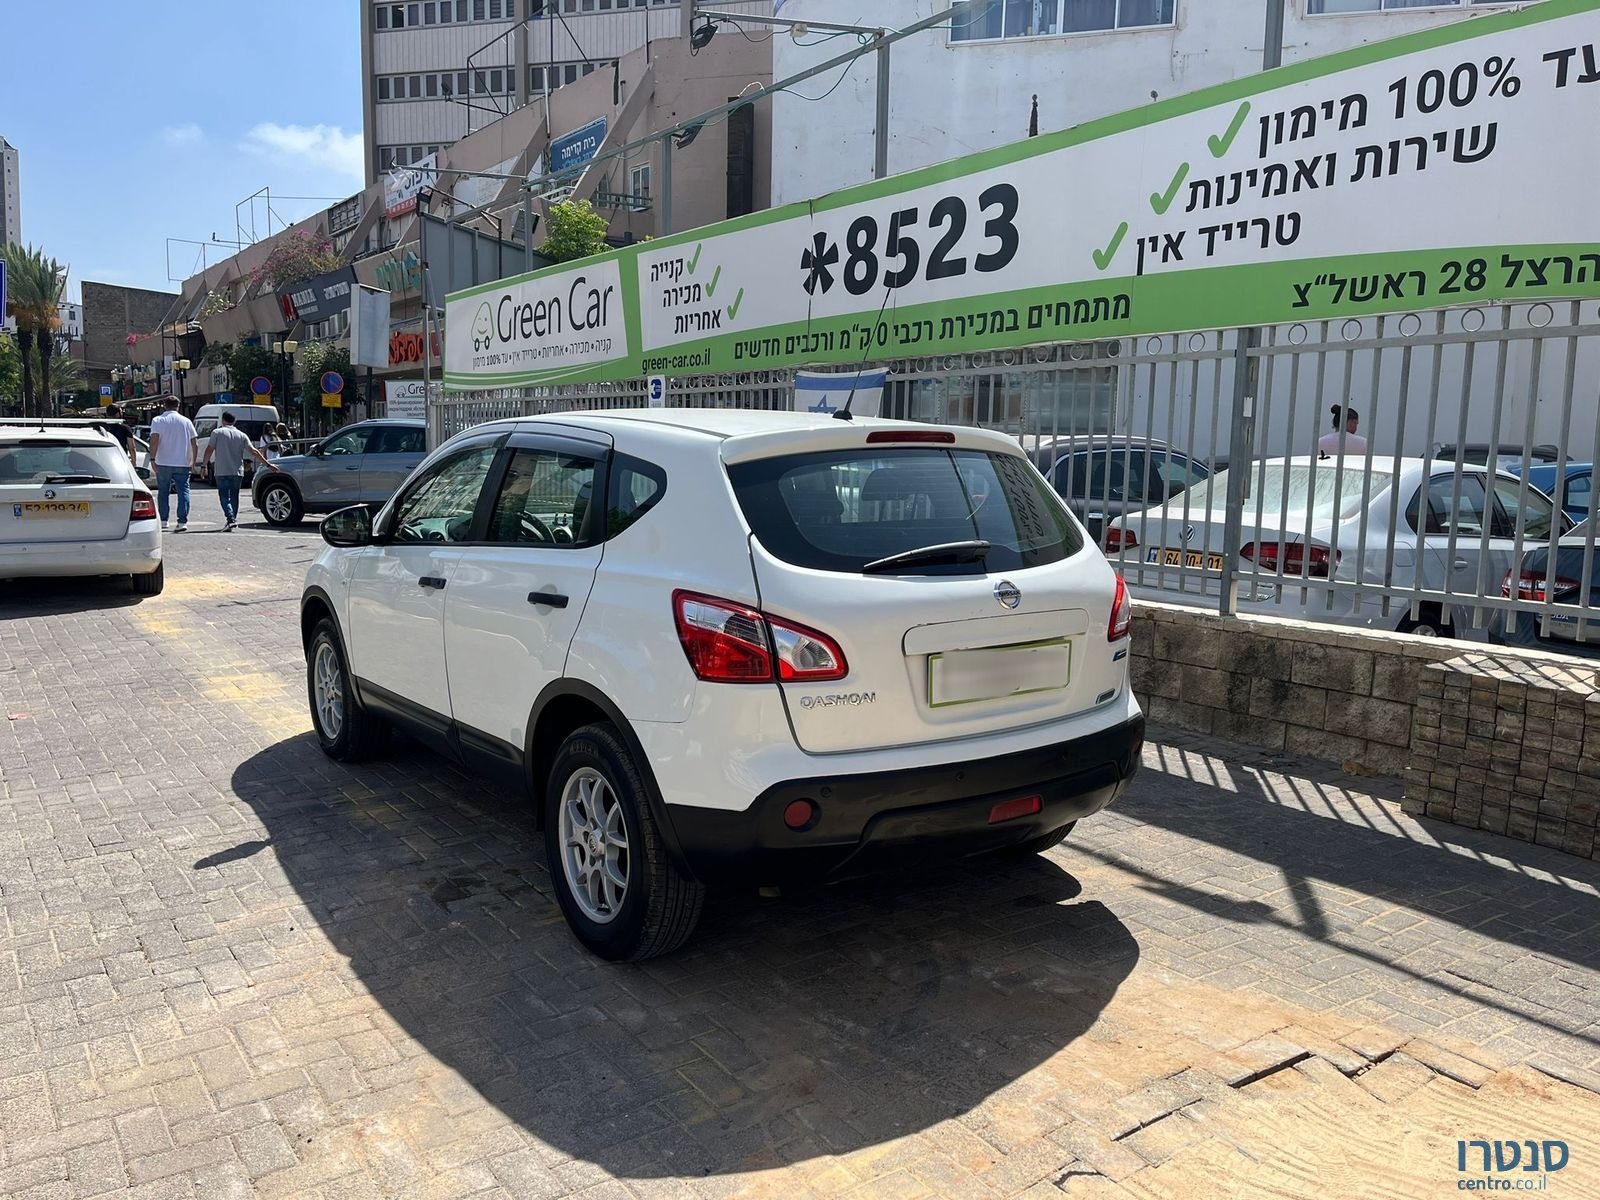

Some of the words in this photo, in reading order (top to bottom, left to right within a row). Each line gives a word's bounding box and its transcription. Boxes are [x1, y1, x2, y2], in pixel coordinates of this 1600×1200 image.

[1388, 56, 1521, 118] 100%
[1258, 93, 1368, 158] מימון
[583, 136, 596, 150] בית
[1350, 122, 1498, 183] שירות
[1186, 152, 1337, 213] ואמינות
[1198, 212, 1301, 256] טרייד
[1136, 230, 1187, 276] אין
[650, 258, 684, 283] קנייה
[1438, 258, 1487, 294] 28
[1500, 254, 1600, 288] הרצל
[663, 283, 701, 307] מכירה
[496, 294, 561, 343] Green
[568, 276, 614, 331] Car
[674, 309, 721, 334] אחריות
[1027, 294, 1131, 329] מתמחים
[893, 320, 933, 344] רכבי
[939, 308, 1020, 340] במכירת
[542, 344, 565, 358] אחריות
[569, 341, 590, 356] מכירה
[595, 338, 612, 354] קניה
[734, 337, 780, 360] חדשים
[785, 331, 834, 355] ורכבים
[486, 354, 501, 366] 100%
[642, 347, 711, 375] green-car.co.il
[800, 691, 876, 709] QASHQAI
